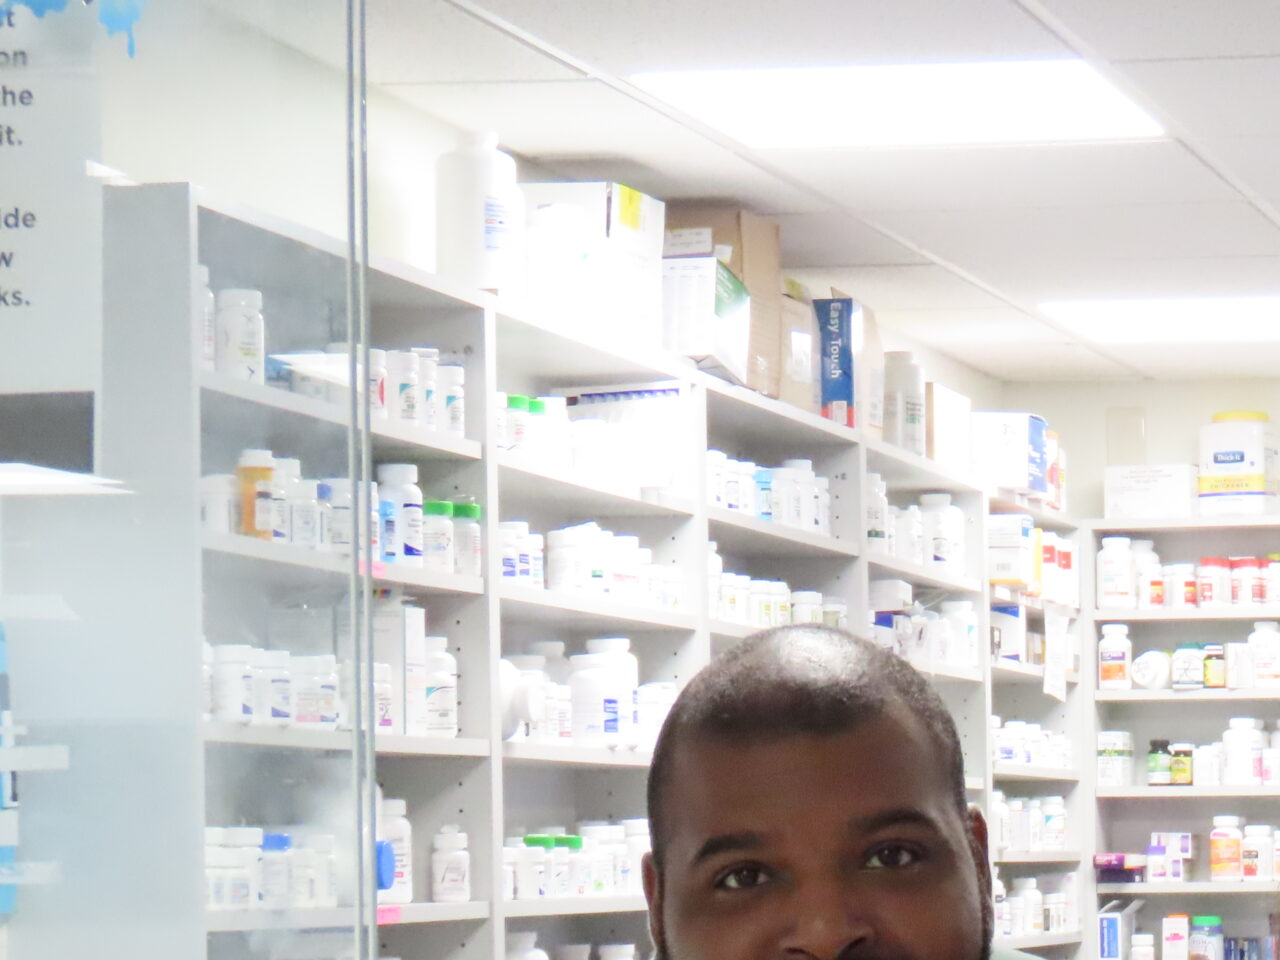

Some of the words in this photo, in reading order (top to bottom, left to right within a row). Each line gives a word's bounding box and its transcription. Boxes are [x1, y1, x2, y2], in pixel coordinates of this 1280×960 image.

[0, 207, 36, 229] de
[828, 302, 842, 333] Easy
[831, 338, 843, 378] Touch
